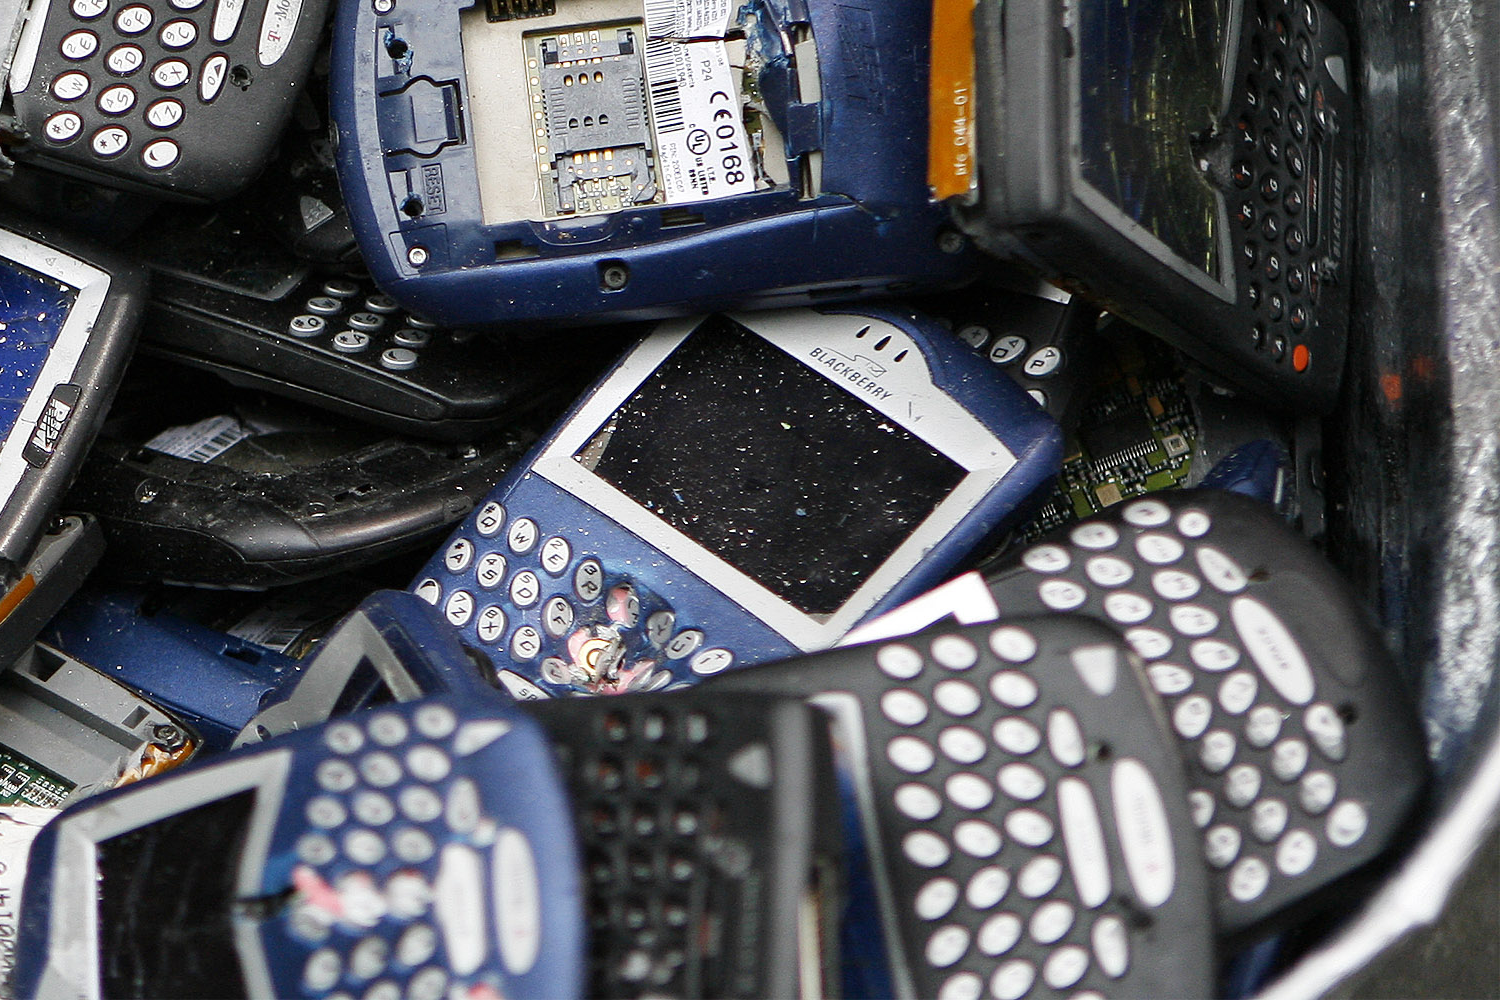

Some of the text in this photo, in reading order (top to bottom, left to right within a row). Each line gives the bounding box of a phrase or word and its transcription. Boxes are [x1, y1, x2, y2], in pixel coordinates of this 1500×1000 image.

[699, 59, 713, 82] P24
[425, 167, 444, 213] RESET
[808, 347, 893, 400] BLACKBERRY
